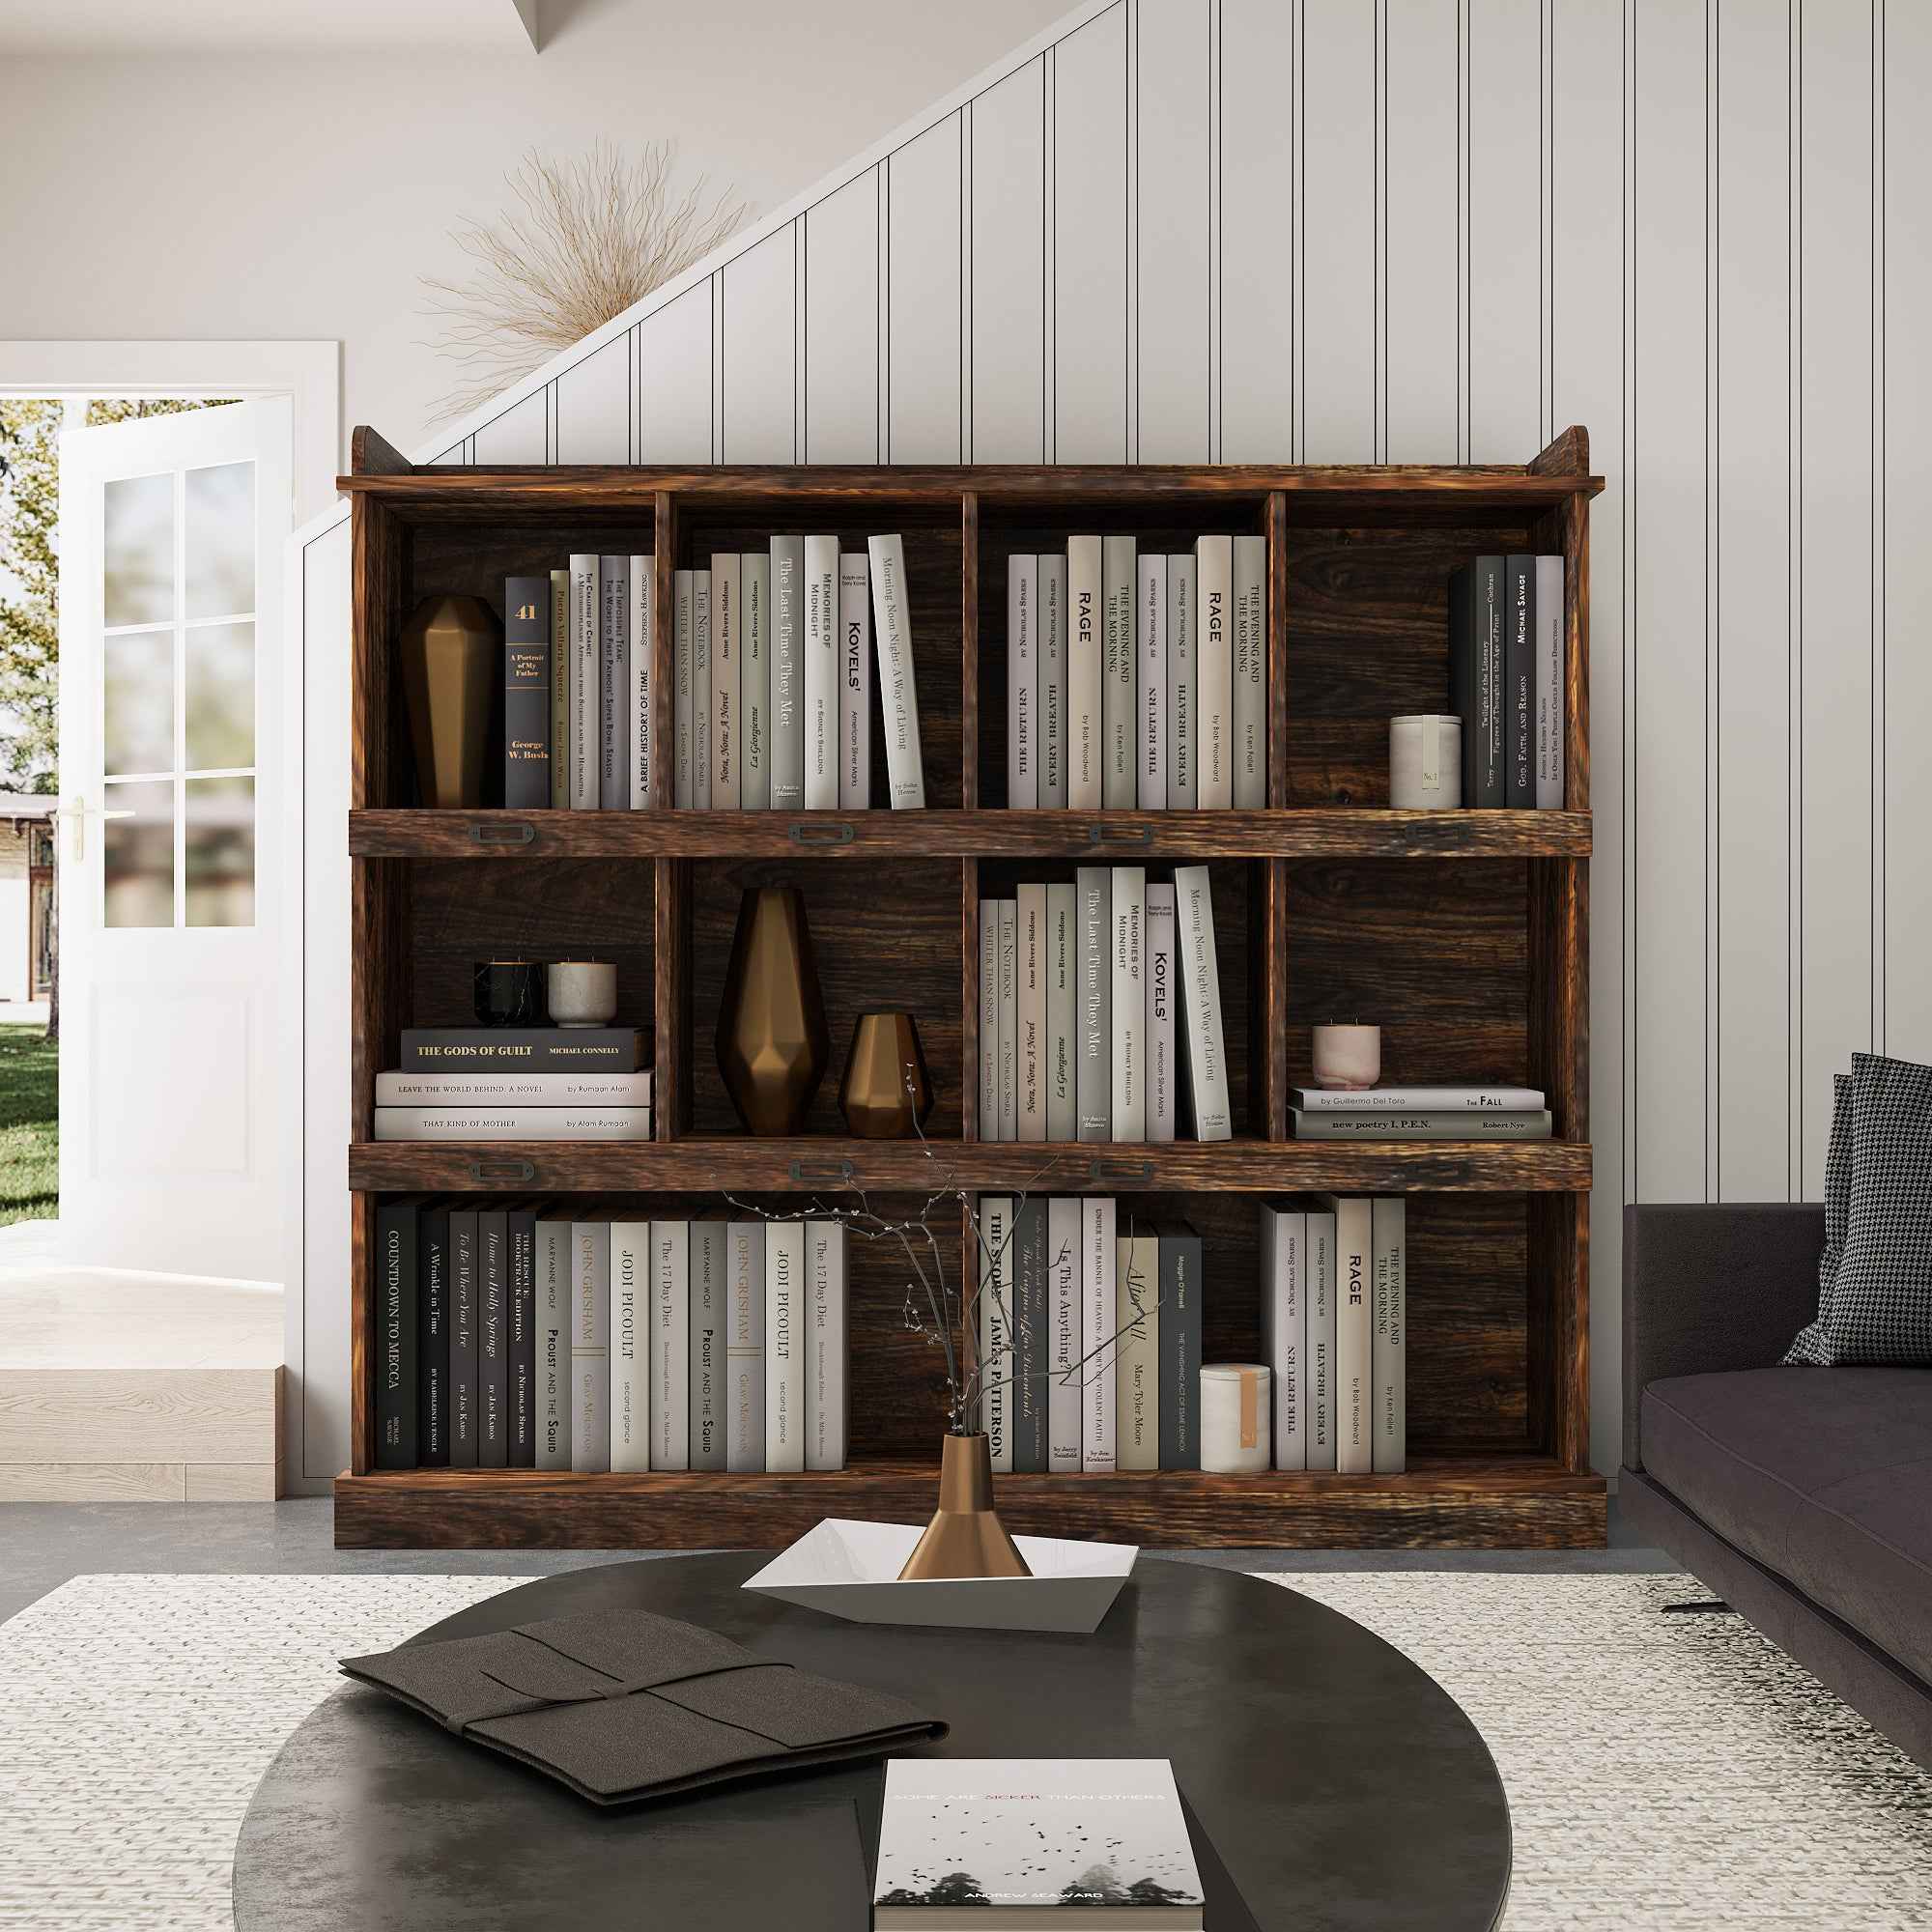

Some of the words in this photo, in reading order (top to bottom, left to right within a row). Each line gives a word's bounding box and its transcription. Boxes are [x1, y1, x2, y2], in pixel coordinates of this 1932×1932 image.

[780, 558, 792, 583] The
[883, 557, 894, 601] Morning
[780, 588, 792, 619] Last
[1251, 585, 1260, 606] THE
[515, 605, 536, 619] 41
[887, 605, 897, 631] Noon
[1080, 593, 1091, 641] RAGE
[1209, 593, 1221, 641] RAGE
[780, 624, 792, 657] Time
[1108, 620, 1117, 672] MORNING
[1121, 611, 1129, 657] EVENING
[1238, 620, 1247, 672] MORNING
[1251, 611, 1260, 657] EVENING
[778, 662, 792, 696] They
[1121, 660, 1129, 683] AND
[1251, 660, 1260, 683] AND
[640, 696, 648, 709] OF
[893, 680, 903, 701] Way
[780, 700, 792, 726] Met
[895, 704, 906, 715] of
[1049, 685, 1058, 737] BREATH
[1212, 715, 1220, 724] by
[895, 718, 908, 751] Living
[640, 784, 649, 793] A
[1088, 890, 1099, 915] The
[1088, 921, 1100, 951] Last
[1088, 954, 1100, 989] Time
[1087, 993, 1100, 1027] They
[417, 1047, 441, 1056] THE
[443, 1047, 477, 1056] GODS
[480, 1047, 496, 1056] OF
[498, 1047, 532, 1056] GUILT
[1088, 1032, 1100, 1058] Met
[460, 1234, 469, 1246] To
[488, 1233, 498, 1264] Home
[662, 1240, 672, 1261] The
[816, 1240, 827, 1261] The
[460, 1249, 469, 1264] Be
[622, 1251, 633, 1285] JODI
[778, 1251, 788, 1286] JODI
[1060, 1249, 1071, 1262] Is
[1378, 1258, 1387, 1279] THE
[388, 1231, 399, 1317] COUNTDOWN
[431, 1255, 440, 1293] Wrinkle
[459, 1267, 469, 1301] Where
[488, 1268, 497, 1278] to
[662, 1265, 671, 1277] 17
[817, 1265, 826, 1278] 17
[1060, 1266, 1071, 1296] This
[1350, 1256, 1361, 1305] RAGE
[431, 1297, 440, 1307] in
[487, 1281, 499, 1311] Holly
[661, 1280, 671, 1302] Day
[816, 1281, 826, 1301] Day
[460, 1304, 469, 1323] You
[662, 1306, 671, 1327] Diet
[1378, 1283, 1387, 1334] MORNING
[388, 1321, 399, 1338] TO
[431, 1310, 440, 1334] Time
[622, 1293, 634, 1358] PICOULT
[778, 1293, 788, 1358] PICOULT
[1058, 1300, 1071, 1370] Anything?
[459, 1328, 469, 1348] Are
[486, 1315, 498, 1358] Springs
[388, 1342, 399, 1389] MECCA
[1133, 1365, 1143, 1389] Mary
[991, 1371, 1002, 1458] PATTERSON
[1133, 1391, 1143, 1415] Tyler
[623, 1415, 632, 1444] glance
